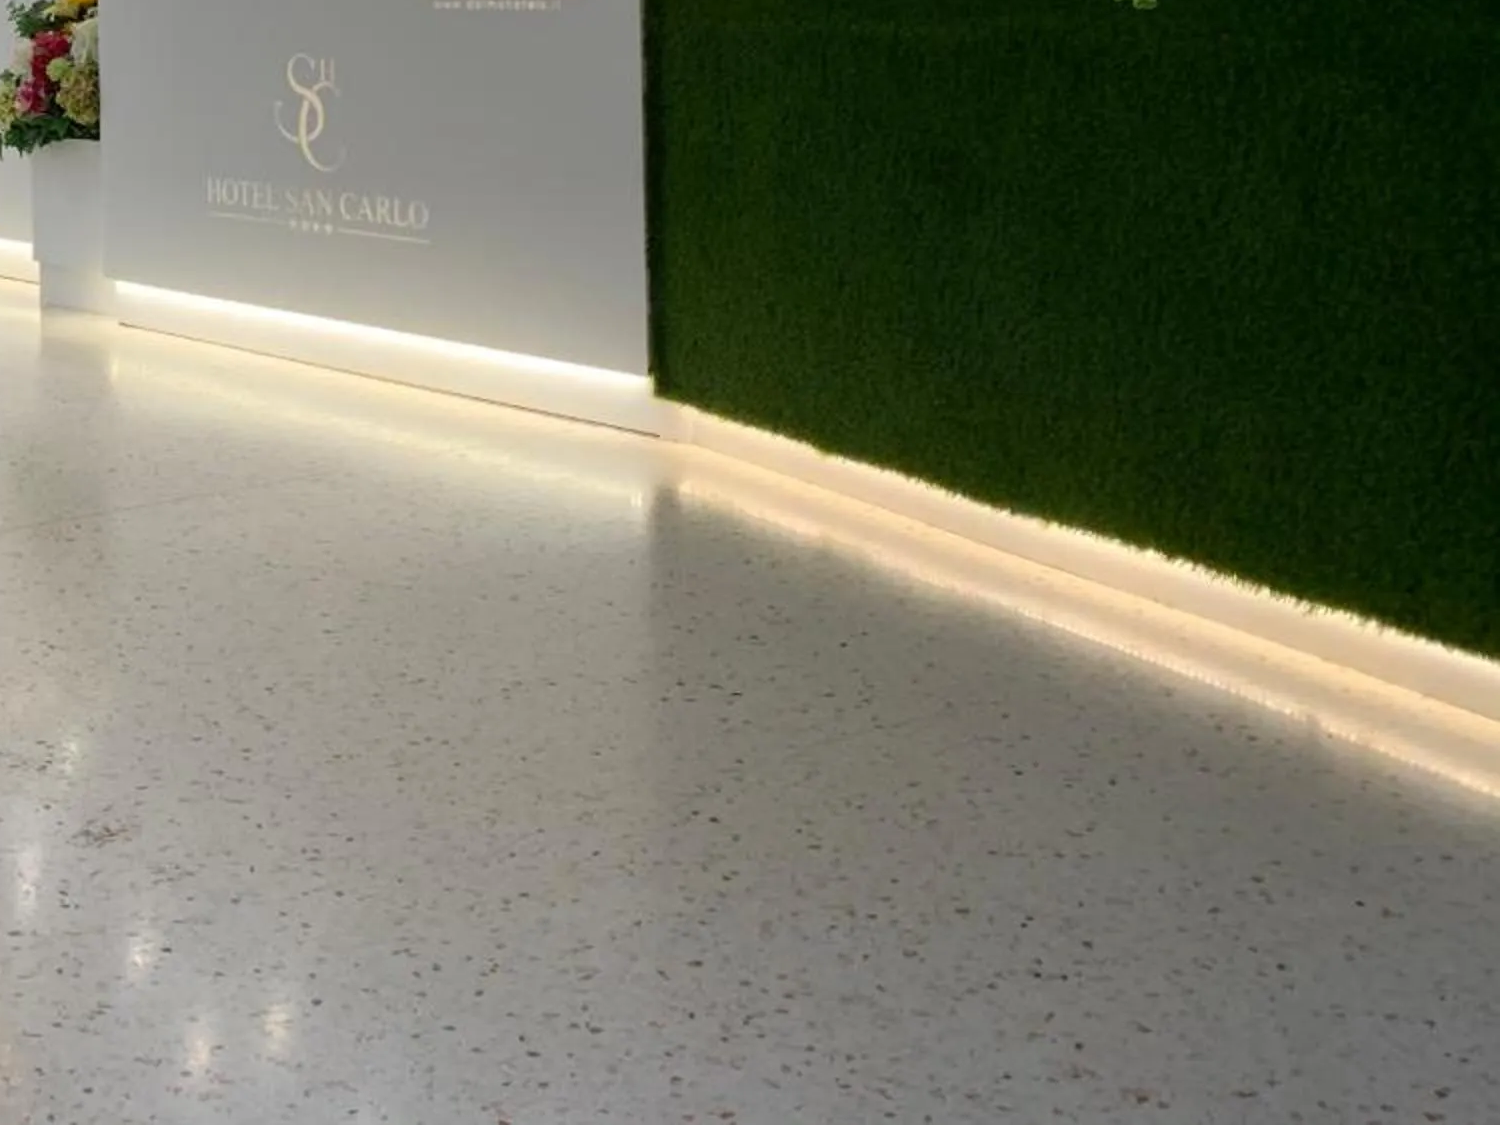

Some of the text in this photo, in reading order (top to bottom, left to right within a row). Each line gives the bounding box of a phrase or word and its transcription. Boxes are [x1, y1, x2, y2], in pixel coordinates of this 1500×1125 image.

[206, 176, 430, 229] HOTEL SAN CARLO
